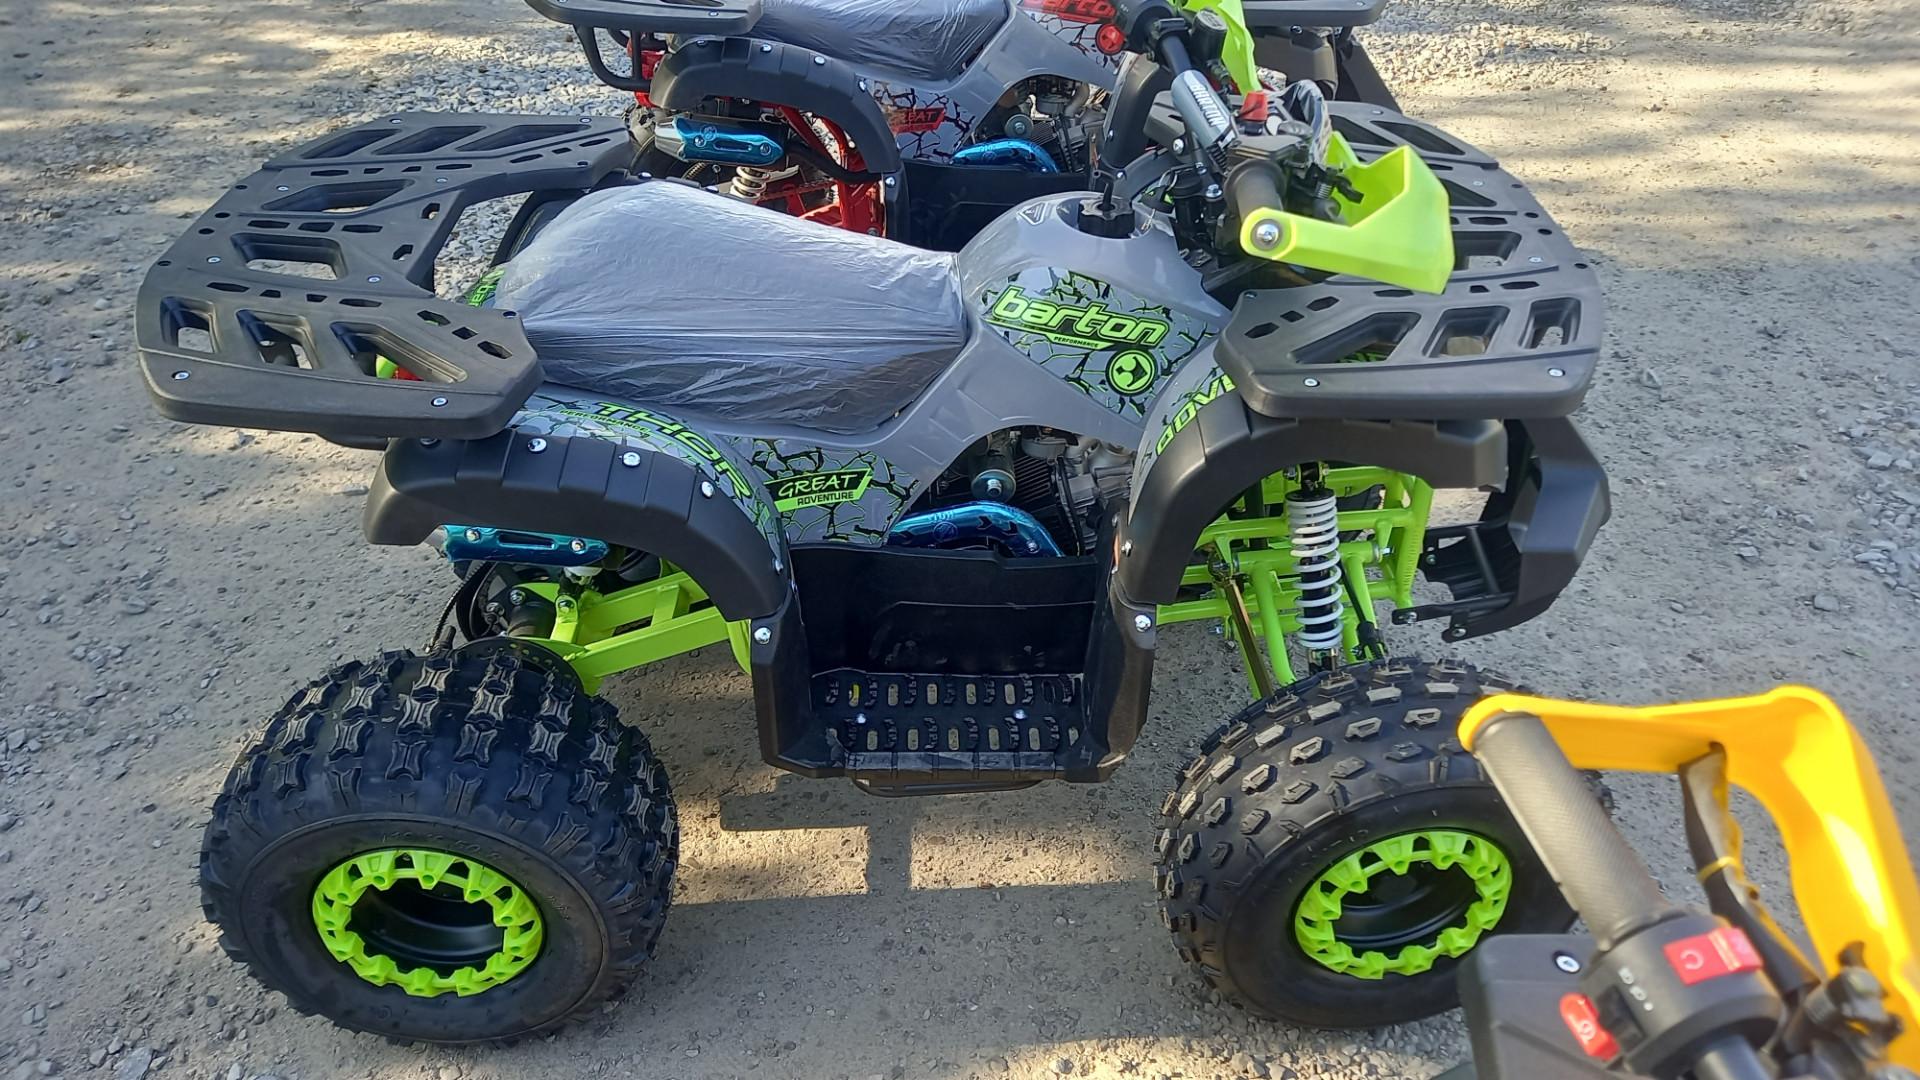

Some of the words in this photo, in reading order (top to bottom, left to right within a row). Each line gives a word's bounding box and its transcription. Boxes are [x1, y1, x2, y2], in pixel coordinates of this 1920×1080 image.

[992, 285, 1170, 346] barton
[1053, 336, 1099, 348] PERFORMANCE
[559, 409, 650, 433] PERFORMANCE
[595, 401, 752, 501] THOR
[778, 474, 858, 498] GREAT
[797, 491, 854, 506] ADVENTURE
